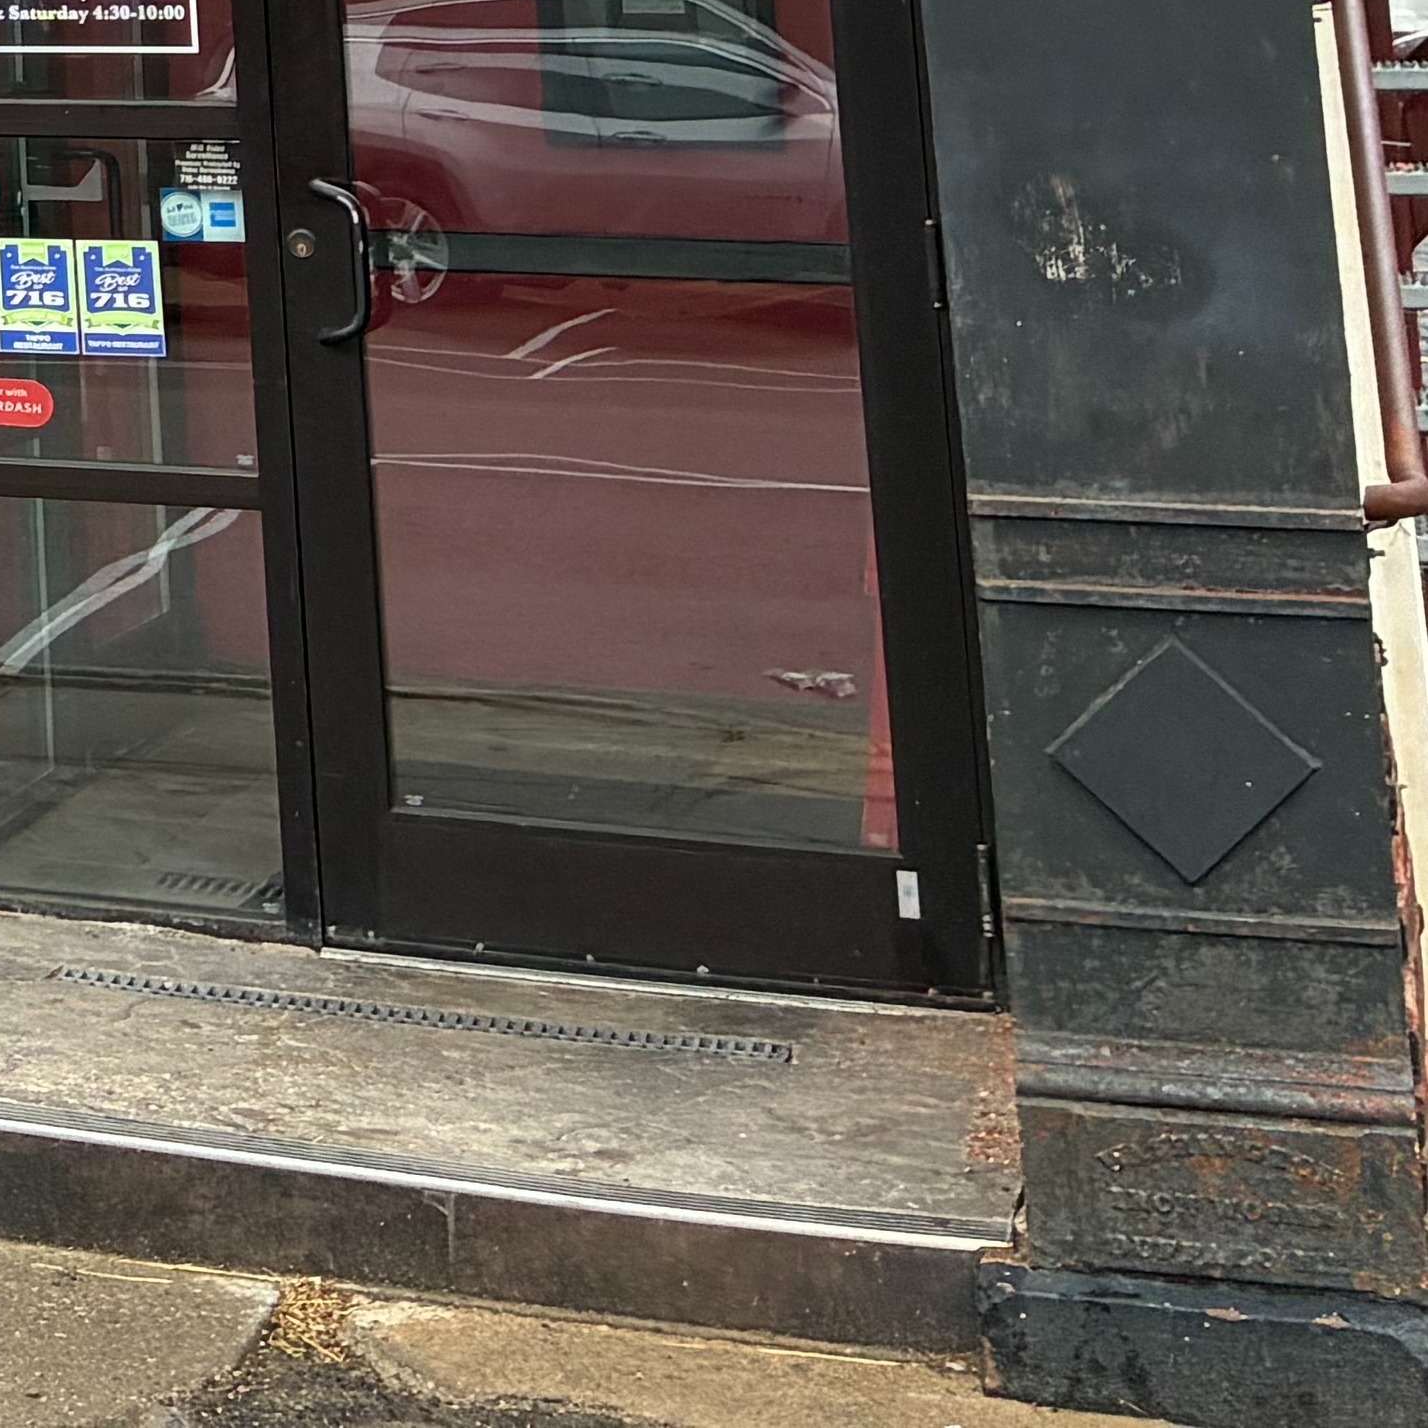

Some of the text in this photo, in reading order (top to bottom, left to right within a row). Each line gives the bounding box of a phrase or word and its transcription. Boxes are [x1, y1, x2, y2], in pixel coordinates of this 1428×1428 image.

[8, 5, 89, 24] Saturday
[92, 5, 185, 20] 4:30-10:00
[10, 271, 56, 289] Best
[95, 273, 141, 291] Best
[6, 290, 65, 306] 716
[91, 292, 150, 308] 716
[5, 389, 28, 397] with
